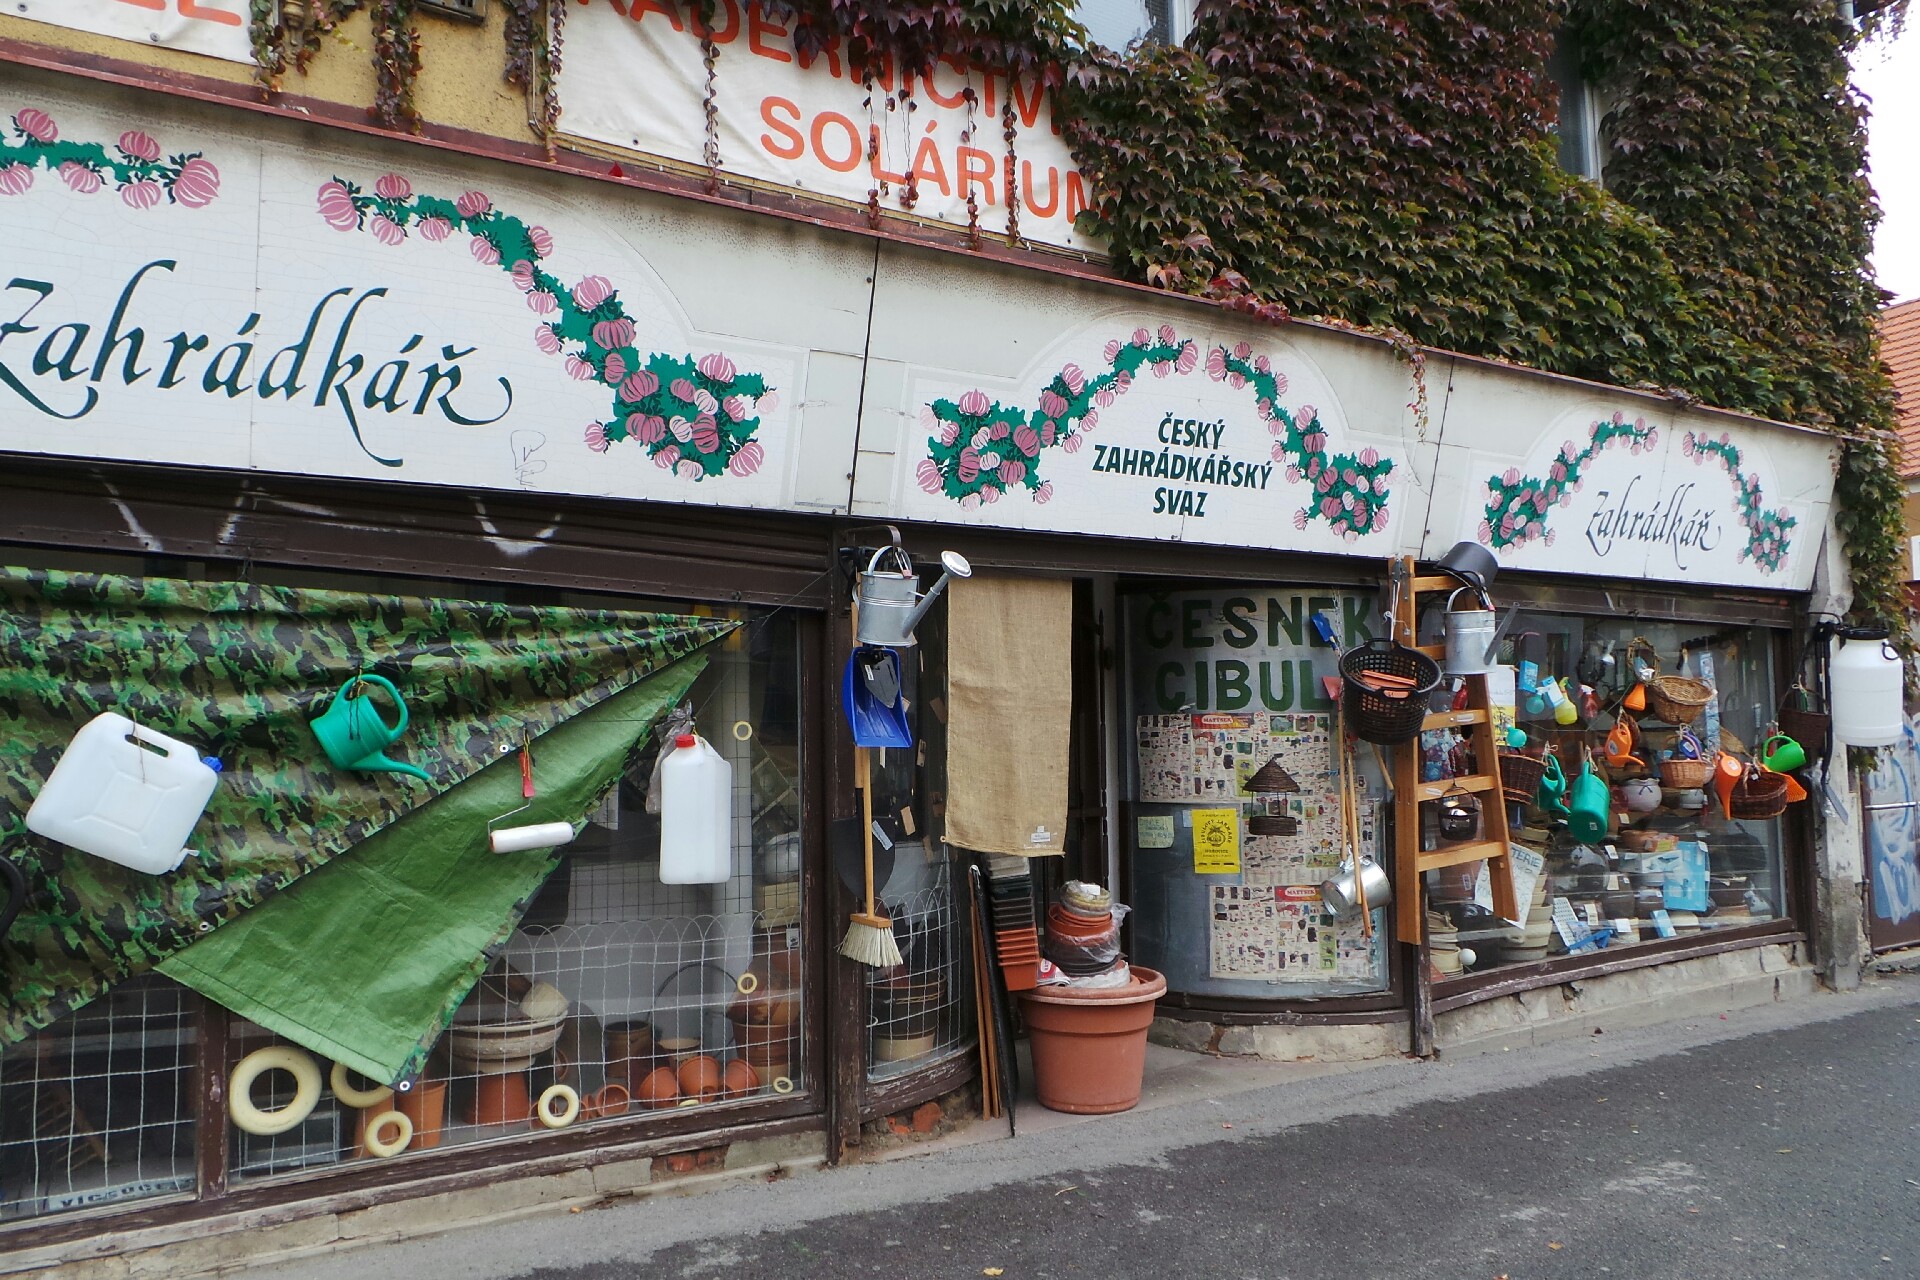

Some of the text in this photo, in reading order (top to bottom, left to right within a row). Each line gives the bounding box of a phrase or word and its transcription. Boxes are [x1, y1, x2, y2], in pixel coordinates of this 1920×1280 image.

[760, 96, 1108, 224] SOLÁRIUM
[0, 259, 512, 468] Zahrádkář
[1158, 412, 1226, 450] ČESKÝ
[1092, 444, 1273, 490] ZAHRÁDKÁŘSKÝ
[1152, 486, 1208, 518] SVAZ
[1585, 475, 1722, 571] Zahrádkář
[1144, 591, 1374, 649] ČESNEK
